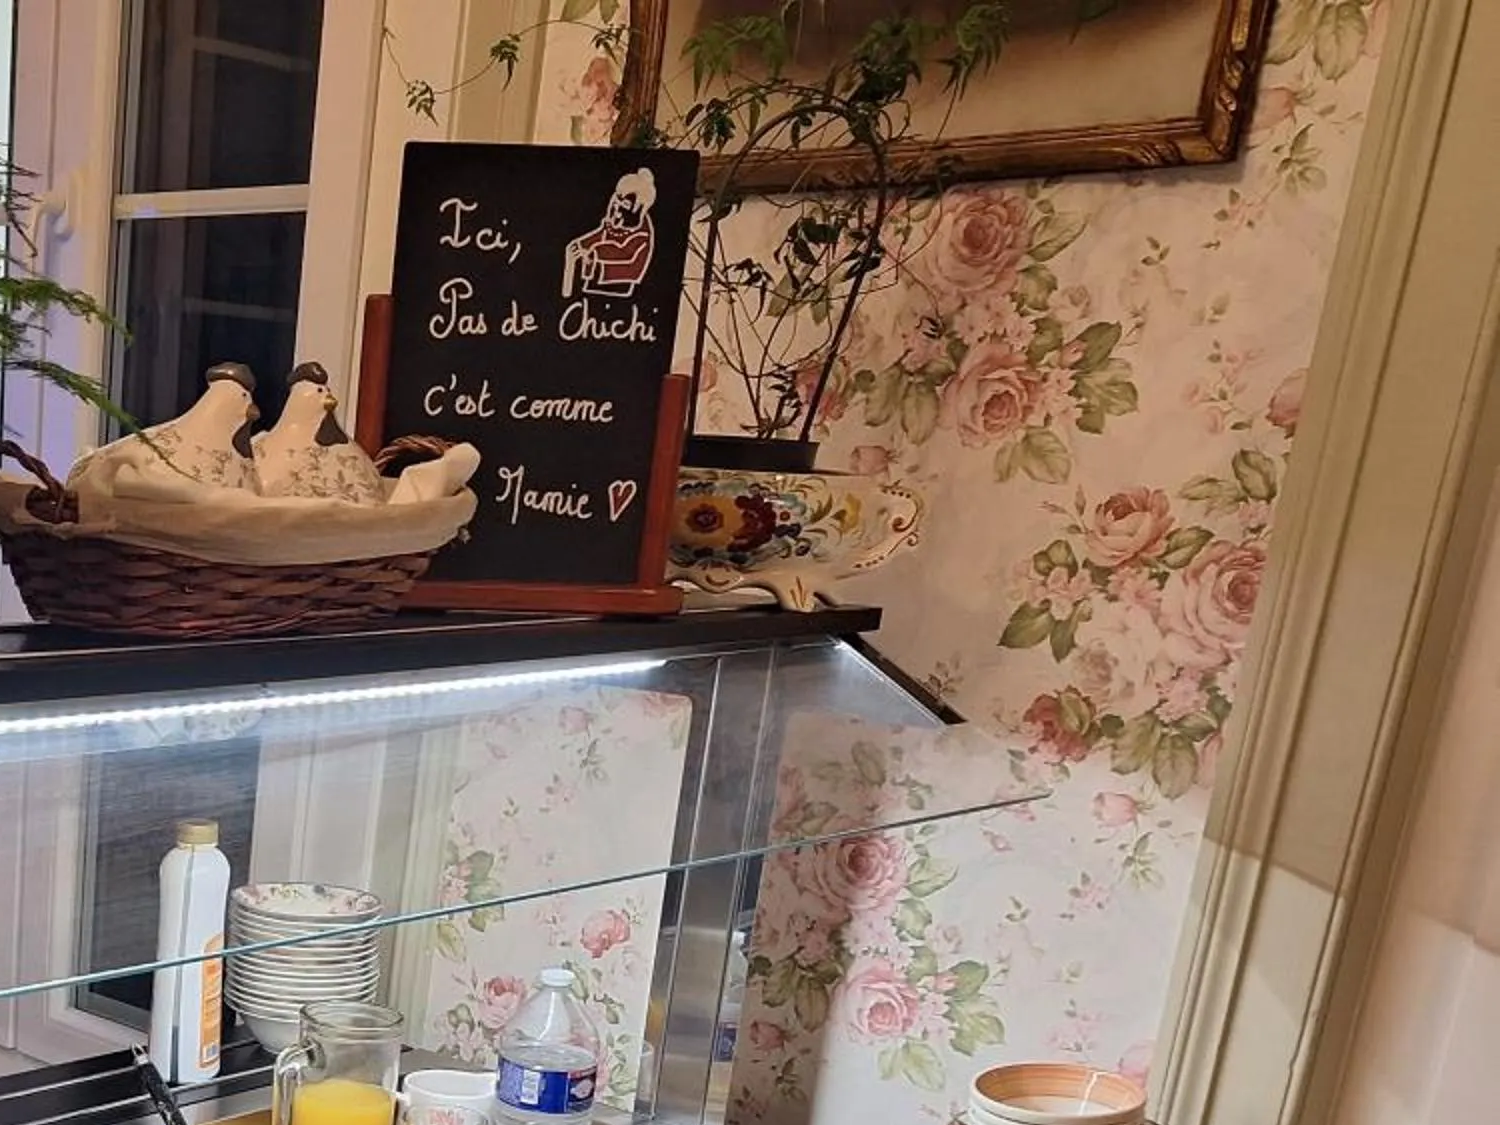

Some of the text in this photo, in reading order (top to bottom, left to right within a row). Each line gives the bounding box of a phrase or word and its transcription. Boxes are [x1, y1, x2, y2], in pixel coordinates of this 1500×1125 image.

[439, 197, 522, 264] Ici,
[429, 277, 487, 339] Pas
[501, 300, 538, 337] de
[510, 394, 614, 423] comme
[495, 465, 592, 524] Mamie
